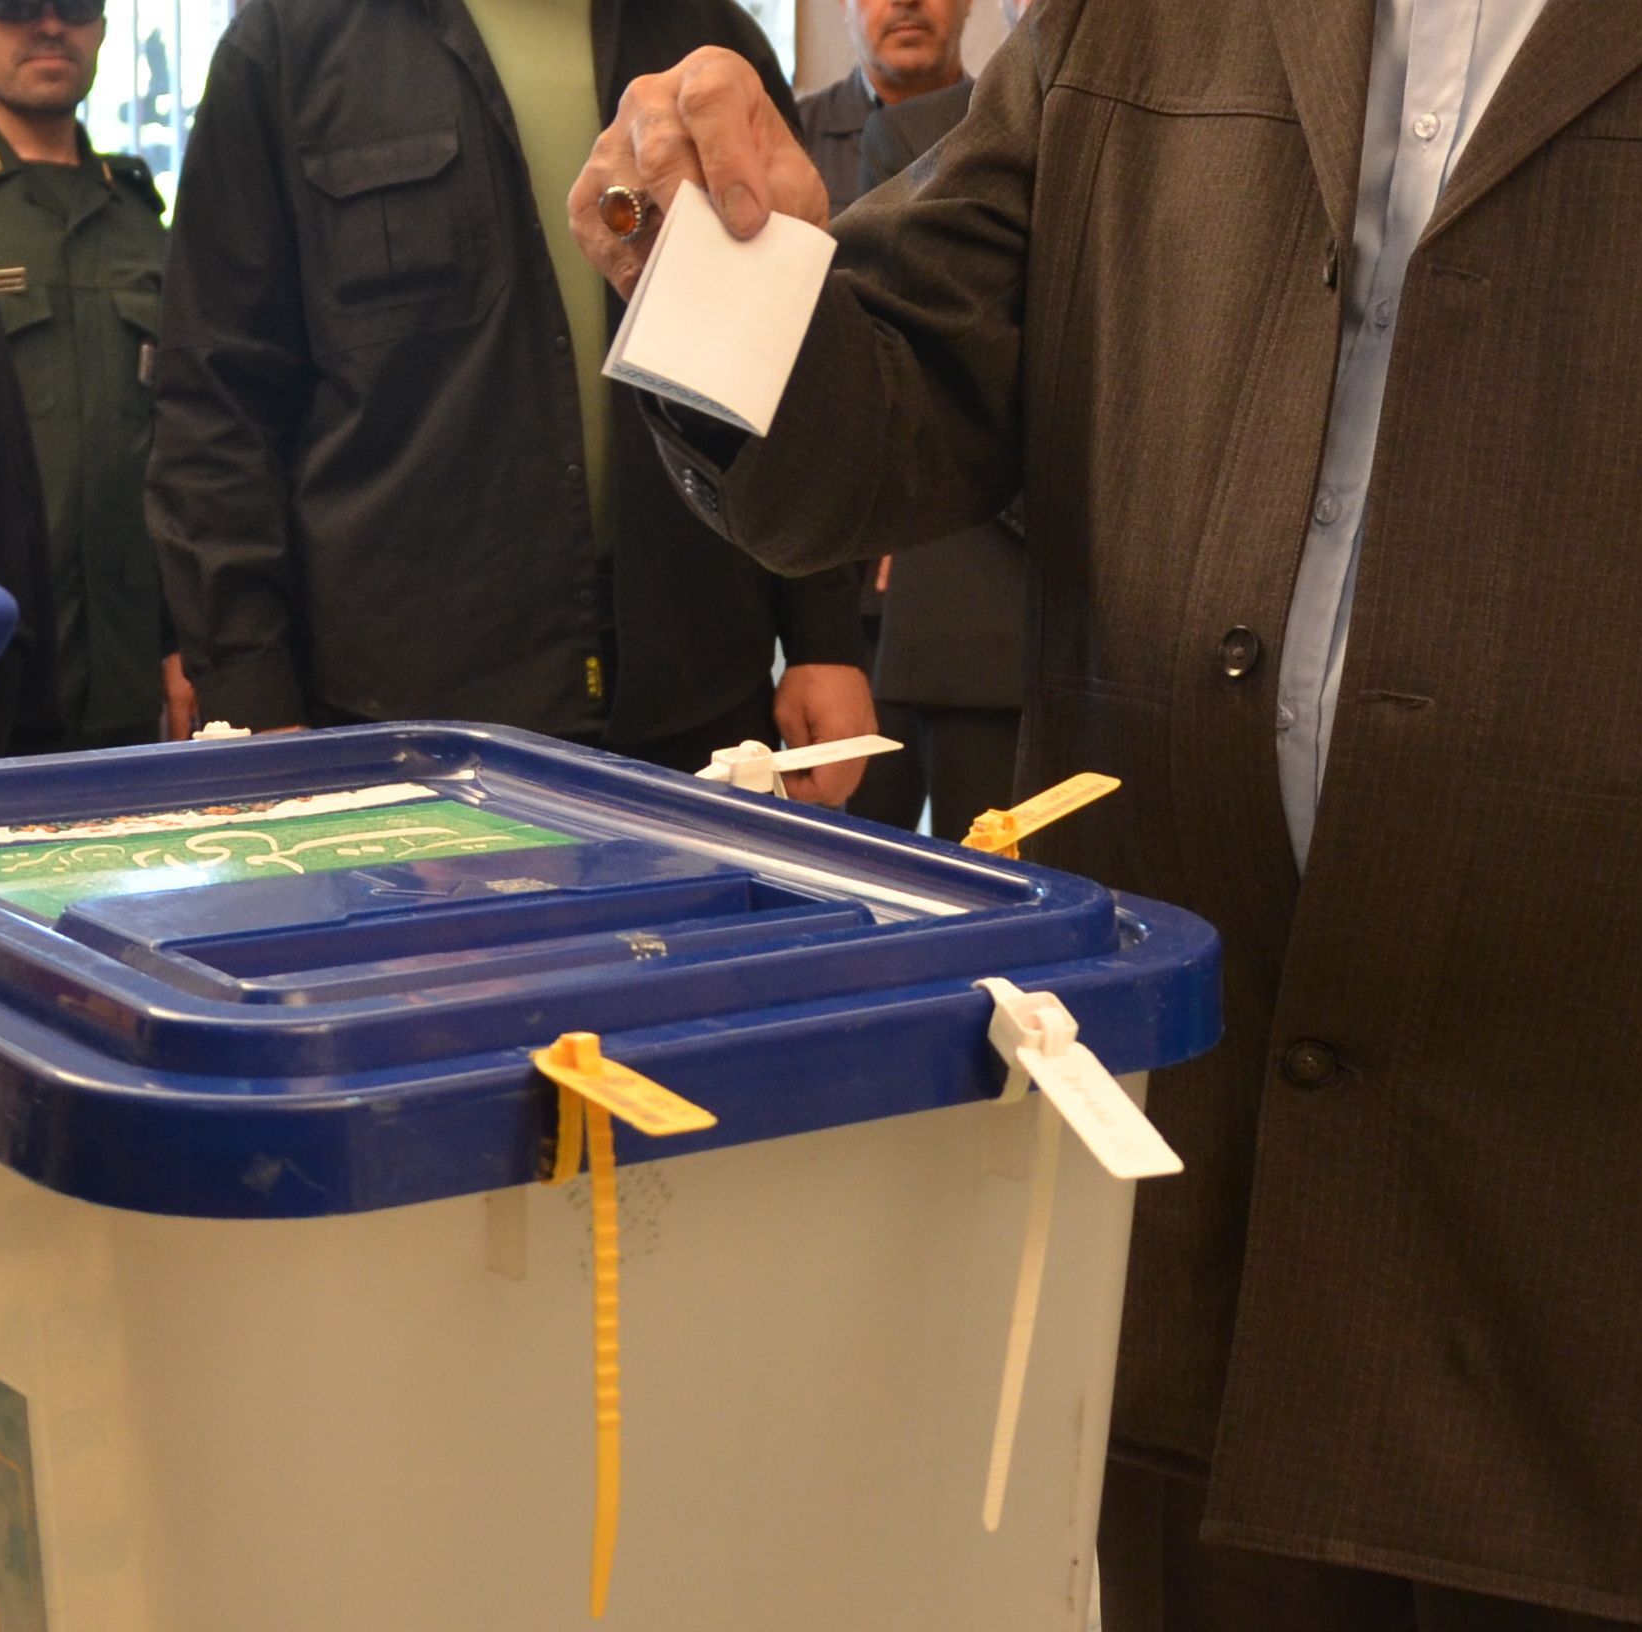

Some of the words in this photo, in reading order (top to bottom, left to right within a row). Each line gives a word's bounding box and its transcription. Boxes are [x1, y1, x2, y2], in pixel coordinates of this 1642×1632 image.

[0, 843, 126, 873] میزان
[244, 826, 463, 876] ملت
[394, 835, 515, 860] است
